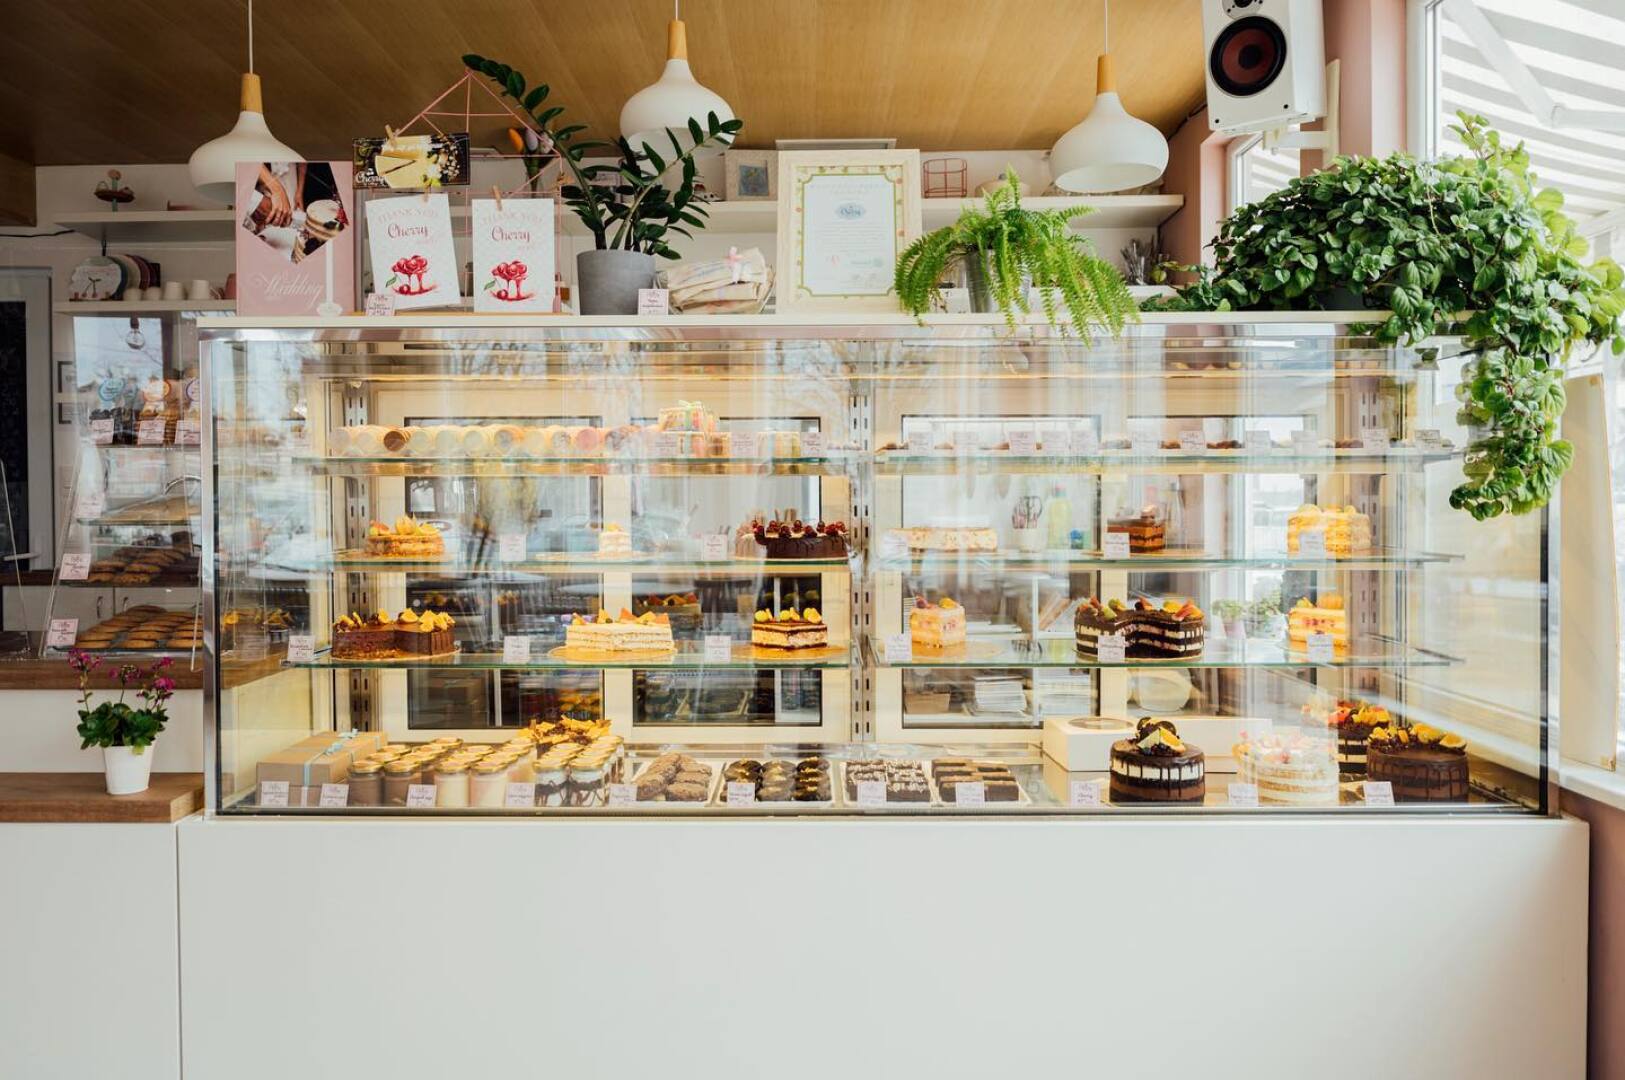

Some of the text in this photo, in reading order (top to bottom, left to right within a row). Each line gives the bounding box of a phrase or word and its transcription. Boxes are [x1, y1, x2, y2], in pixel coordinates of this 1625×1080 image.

[387, 223, 429, 239] Cherry
[491, 225, 531, 242] Cherry
[249, 271, 324, 309] Wedding
